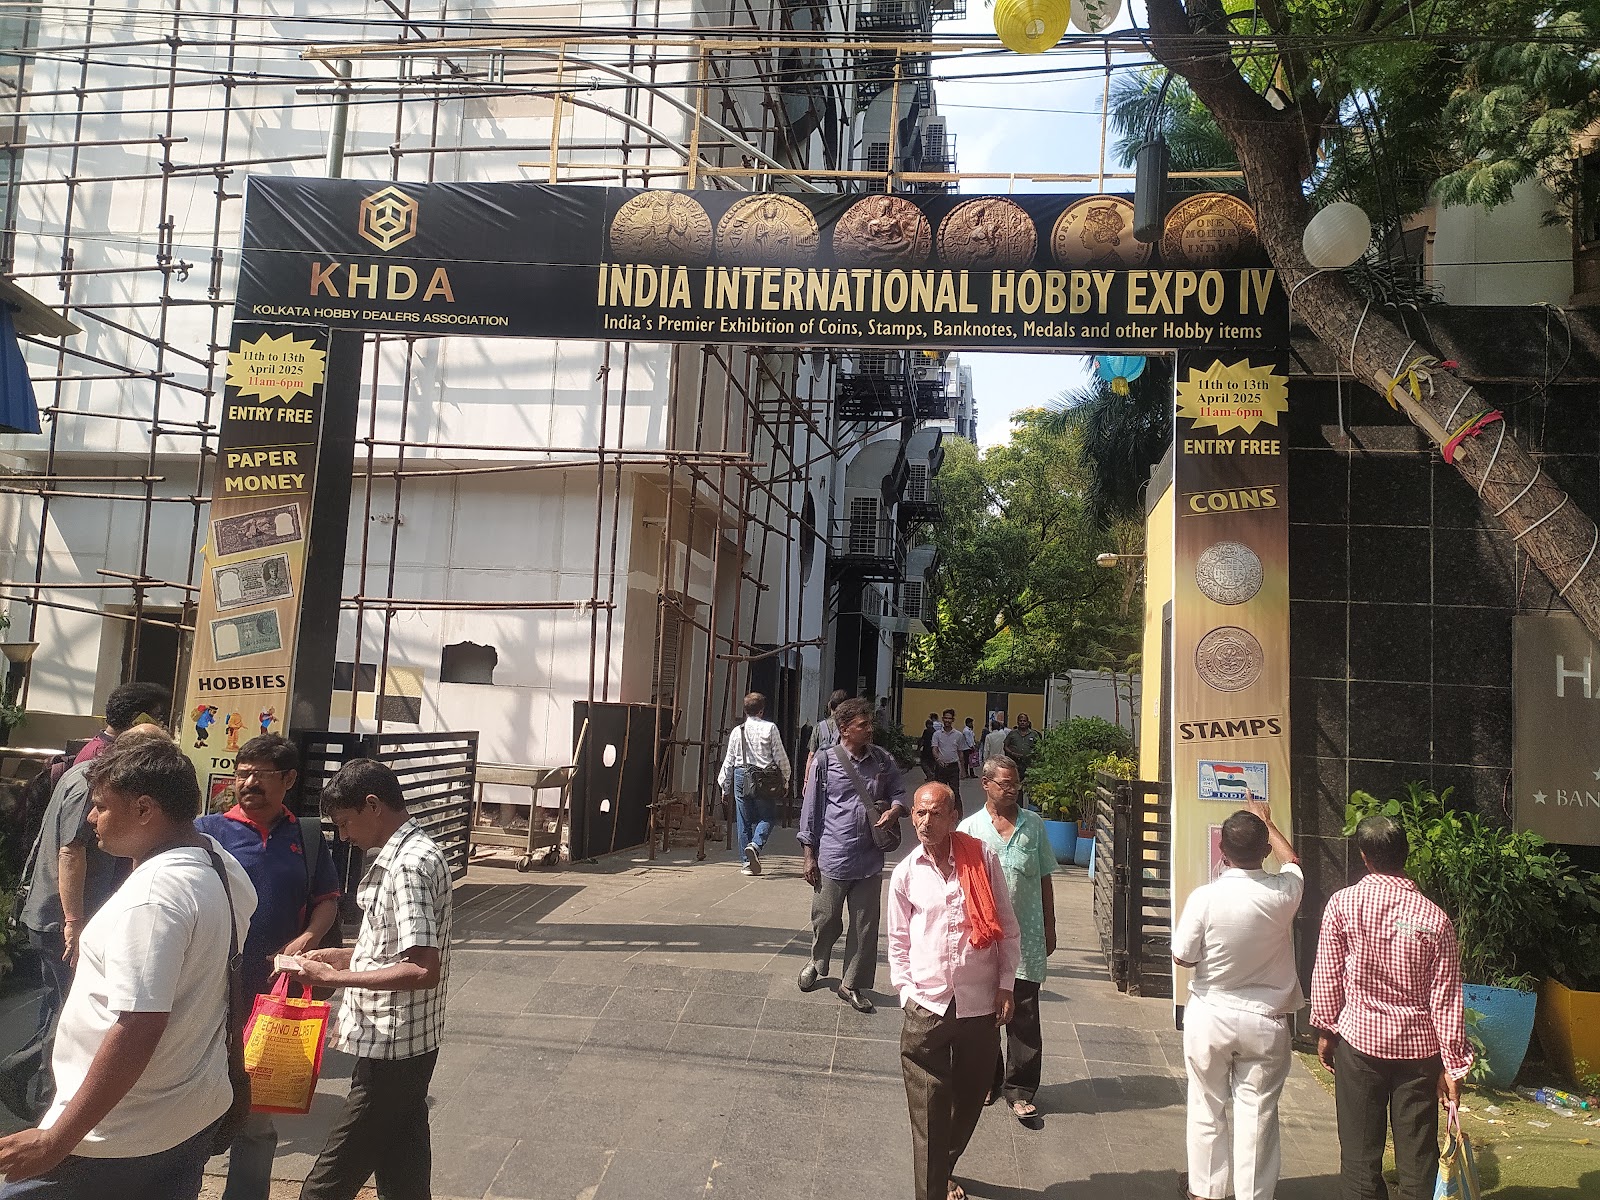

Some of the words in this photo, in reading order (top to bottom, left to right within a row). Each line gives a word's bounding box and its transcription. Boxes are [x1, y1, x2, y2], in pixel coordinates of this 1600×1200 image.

[1196, 218, 1225, 228] ONE
[309, 261, 456, 303] KHDA
[597, 262, 692, 308] INDIA
[703, 265, 979, 314] INTERNATIONAL
[990, 269, 1113, 315] HOBBY
[1126, 269, 1226, 316] EXPO
[1238, 269, 1276, 316] IV
[252, 303, 312, 317] KOLKATA
[313, 307, 360, 320] HOBBY
[362, 309, 421, 322] DEALERS
[423, 312, 509, 326] ASSOCIATION
[603, 313, 654, 331] India's
[657, 315, 716, 333] Premier
[719, 316, 794, 335] Exhibition
[799, 317, 815, 335] of
[818, 318, 863, 338] Coins,
[868, 319, 928, 340] Stamps,
[932, 320, 1018, 340] Banknotes,
[1022, 320, 1076, 339] Medals
[1080, 321, 1111, 339] and
[1115, 322, 1158, 340] other
[1162, 321, 1214, 344] Hobby
[1219, 321, 1263, 340] items
[243, 350, 266, 361] 11th
[268, 353, 279, 362] to
[281, 352, 306, 363] 13th
[247, 364, 276, 376] April
[278, 365, 304, 376] 2025
[248, 376, 305, 390] 11am-6pm
[1197, 379, 1223, 390] 11th
[1227, 381, 1239, 390] to
[1242, 379, 1270, 390] 13th
[1196, 392, 1229, 406] April
[1232, 393, 1262, 404] 2025
[228, 405, 274, 422] ENTRY
[277, 407, 314, 424] FREE
[1199, 406, 1264, 420] 11am-6pm
[1183, 439, 1236, 455] ENTRY
[1240, 439, 1281, 455] FREE
[227, 450, 299, 469] PAPER
[224, 473, 306, 492] MONEY
[1189, 488, 1278, 513] COINS
[198, 674, 286, 691] HOBBIES
[1556, 655, 1600, 699] H
[1179, 717, 1282, 741] STAMPS
